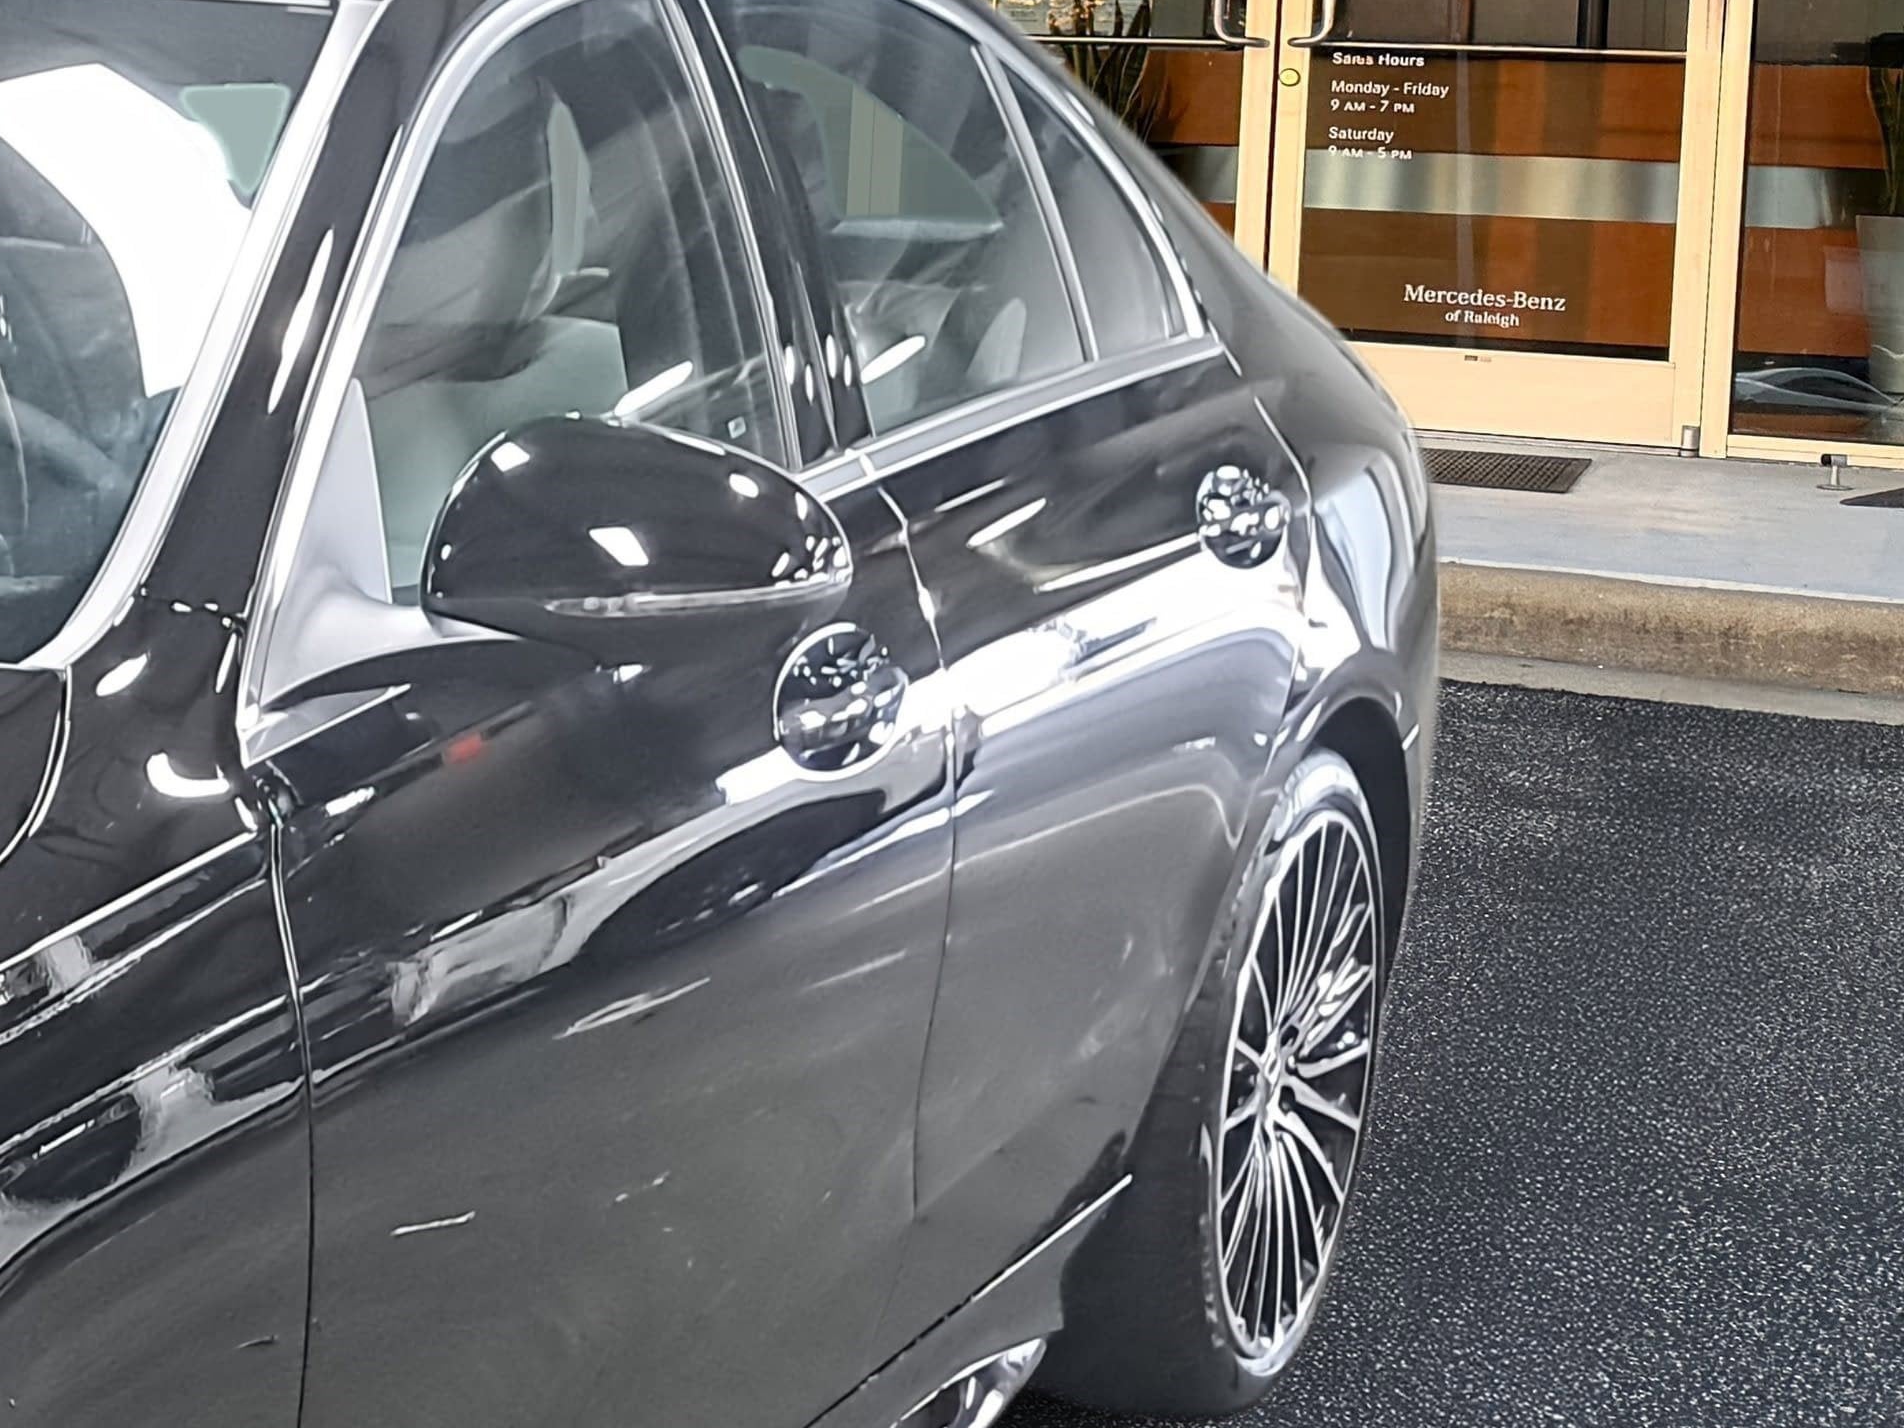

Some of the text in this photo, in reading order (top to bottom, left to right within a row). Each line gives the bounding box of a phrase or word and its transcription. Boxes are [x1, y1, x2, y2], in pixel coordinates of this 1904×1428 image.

[1378, 53, 1425, 67] Hours
[1330, 79, 1391, 97] Monday
[1403, 81, 1450, 99] Friday
[1330, 98, 1340, 112] 9
[1343, 101, 1367, 112] AM
[1379, 99, 1389, 113] 7
[1393, 102, 1416, 114] PM
[1328, 126, 1395, 144] Saturday
[1328, 145, 1338, 158] 9
[1377, 146, 1387, 159] 5
[1391, 149, 1413, 160] PM
[1403, 283, 1567, 312] Mercedes-Benz
[1445, 309, 1520, 328] of Raleigh
